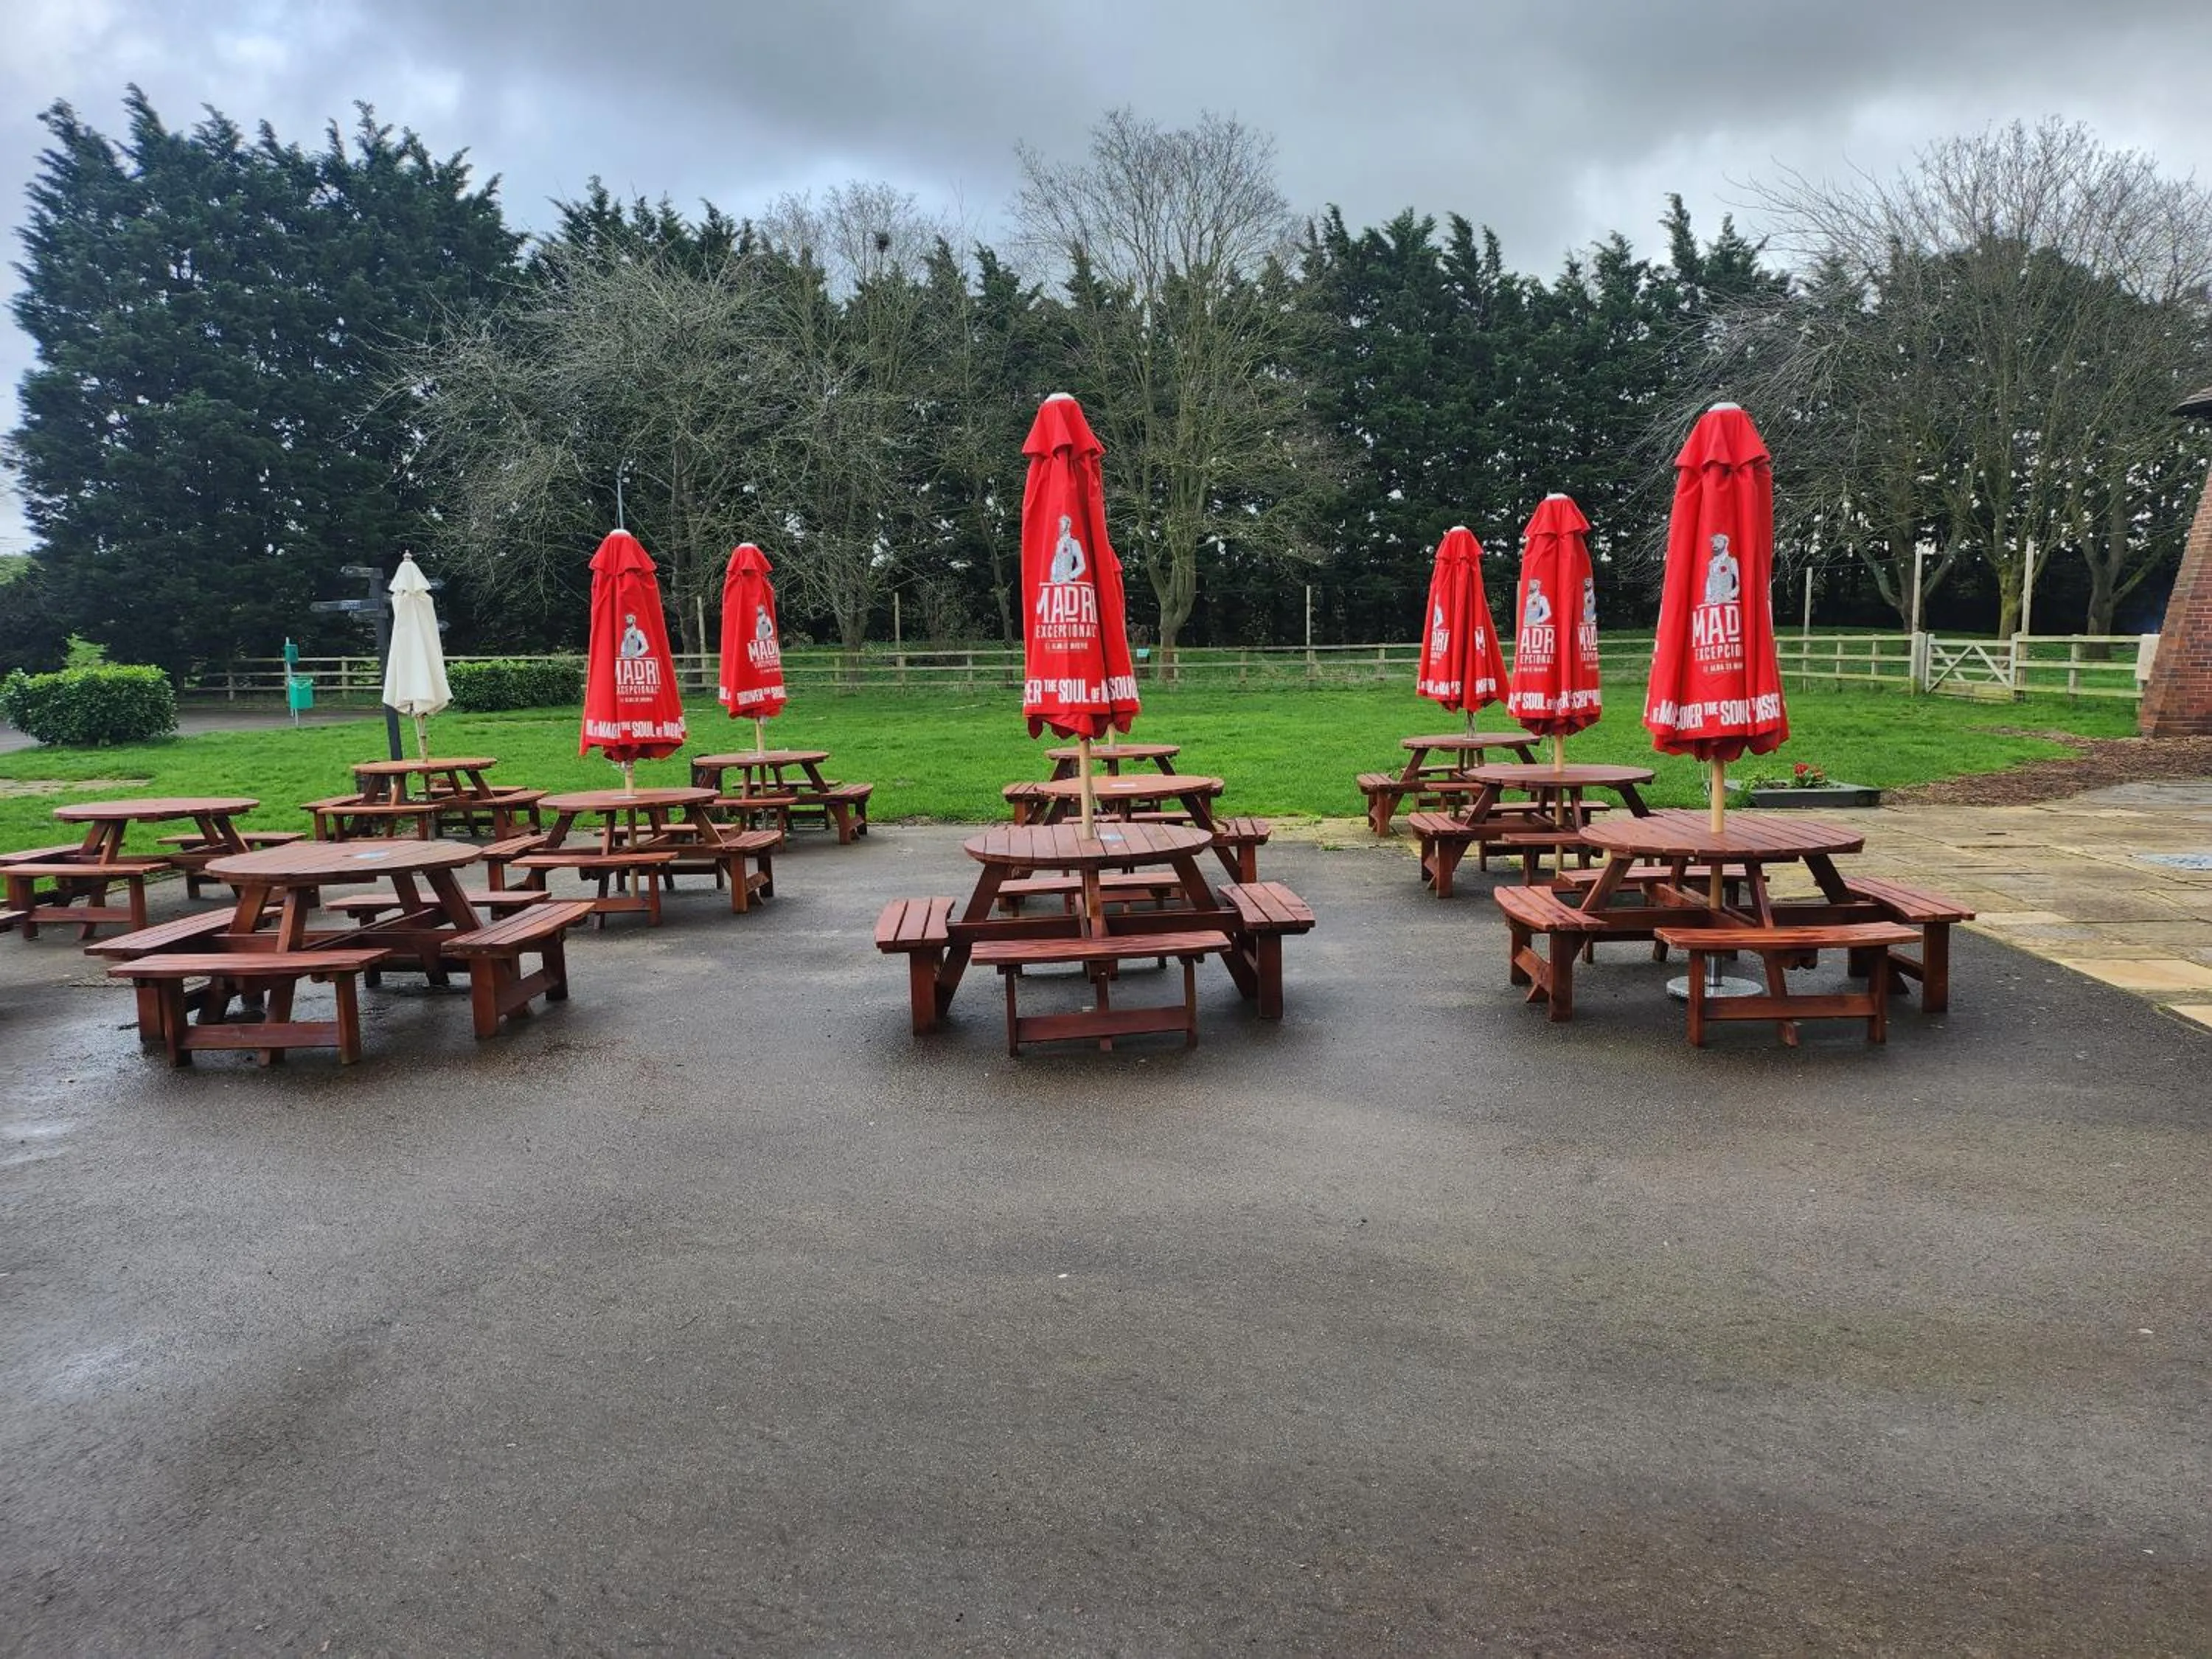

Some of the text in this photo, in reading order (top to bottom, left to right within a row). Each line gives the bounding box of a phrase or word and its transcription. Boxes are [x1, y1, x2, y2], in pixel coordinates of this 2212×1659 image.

[1044, 679, 1057, 693] THE
[1058, 678, 1090, 704] SOUL
[1704, 701, 1719, 715] THE
